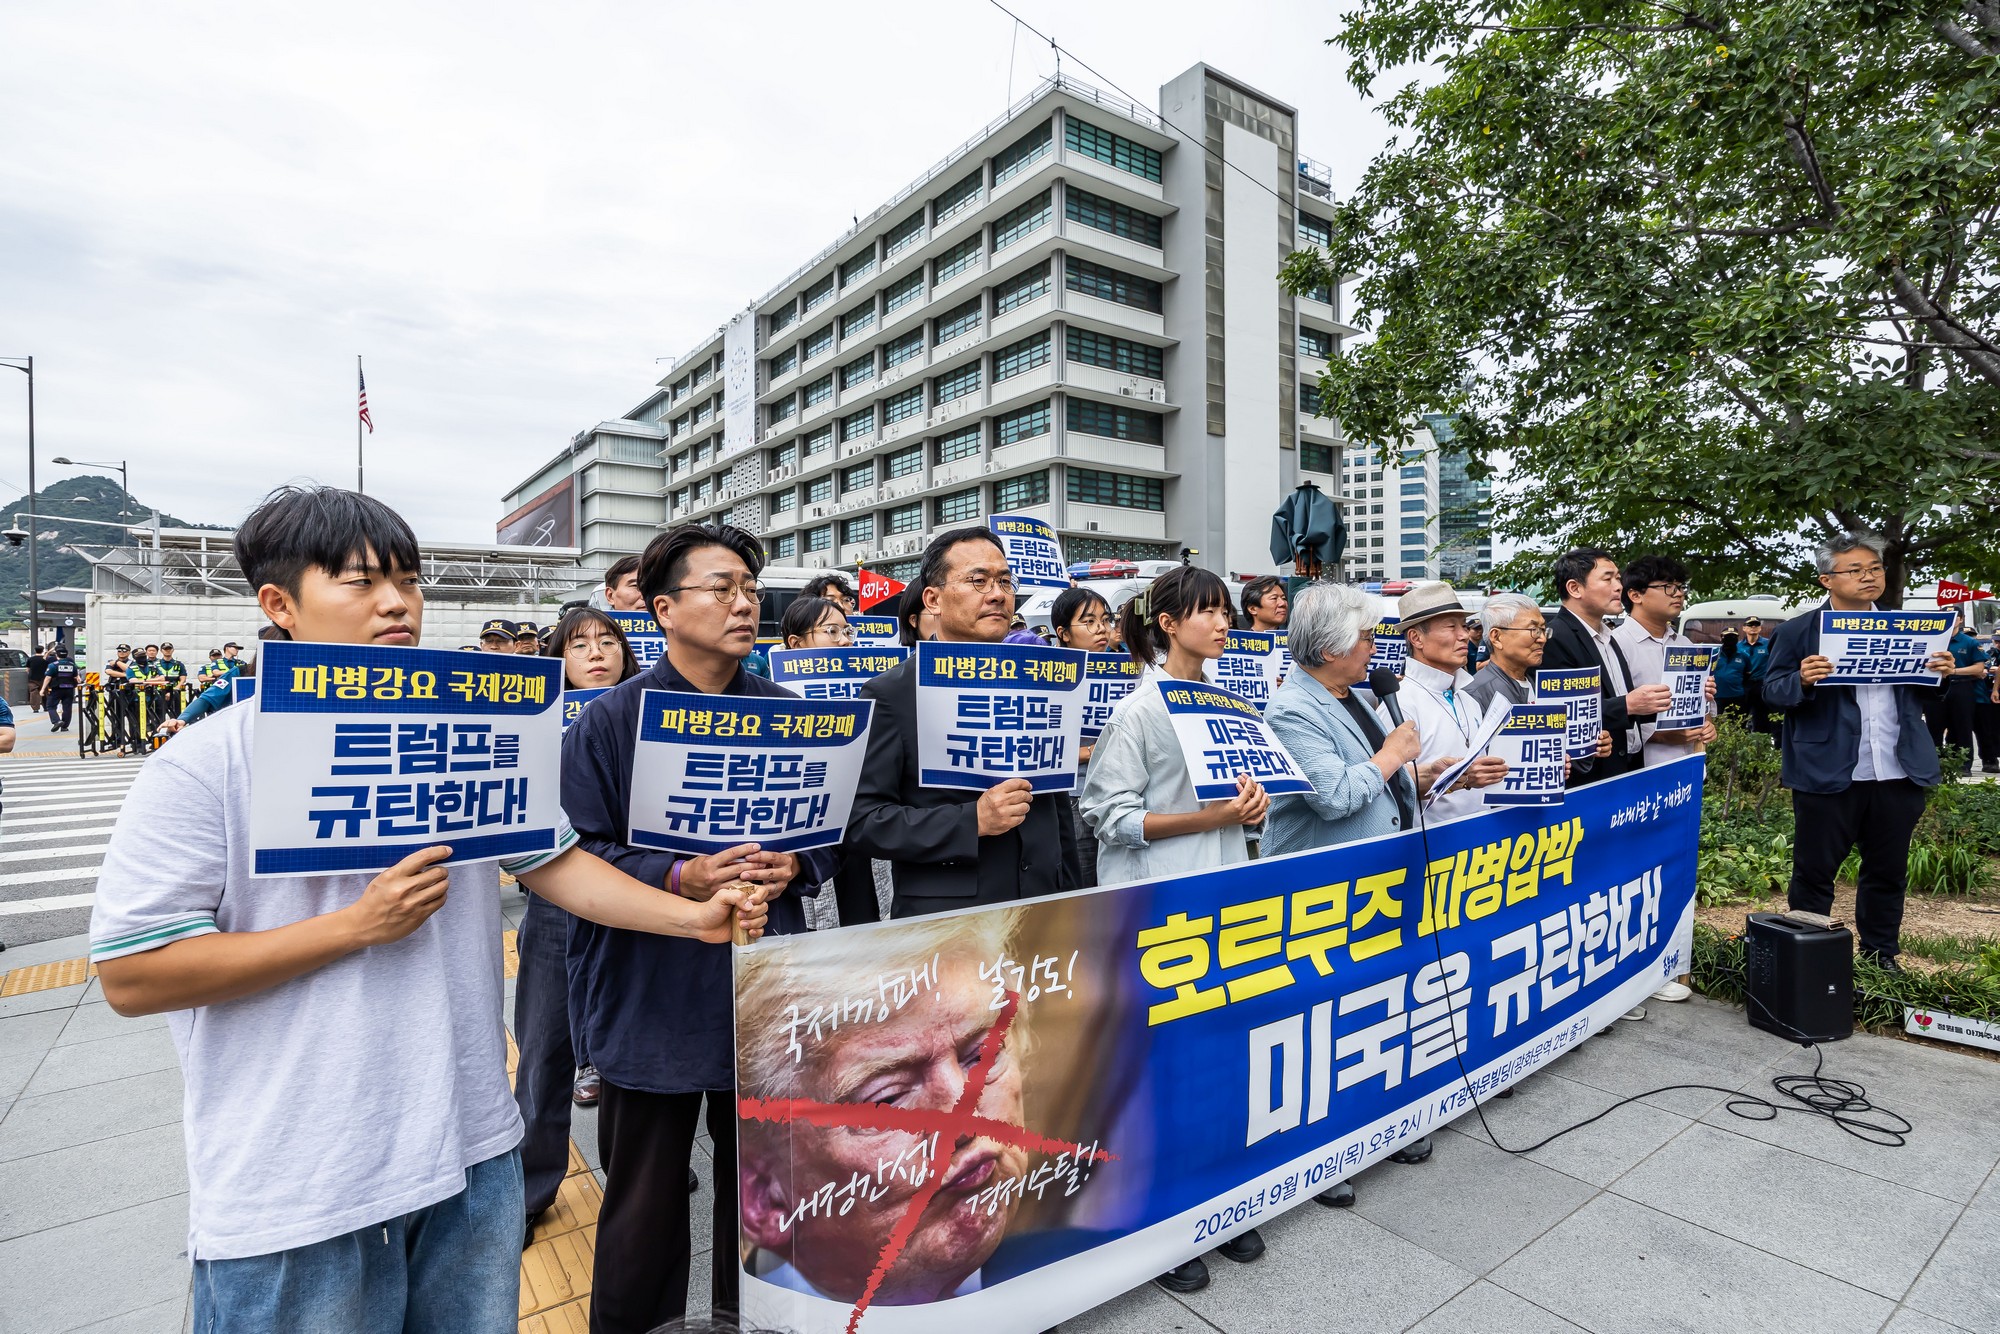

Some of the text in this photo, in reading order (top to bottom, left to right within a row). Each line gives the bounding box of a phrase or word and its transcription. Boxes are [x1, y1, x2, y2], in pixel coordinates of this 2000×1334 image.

[997, 521, 1034, 533] 파병강요
[1010, 539, 1058, 559] 트럼프를
[1006, 558, 1064, 578] 규탄한다!
[861, 580, 890, 599] 43기-3
[1939, 588, 1974, 600] 43기-1
[615, 618, 658, 632] 병강요
[856, 622, 893, 634] 국제깡패
[1372, 624, 1400, 636] 병강
[1832, 618, 1947, 631] 파병강요 국제깡패
[1240, 638, 1270, 652] 국제깡패
[1846, 638, 1927, 656] 트럼프를
[783, 656, 900, 674] 파병강요 국제깡패
[932, 656, 1078, 684] 파병강요 국제깡패
[1086, 662, 1118, 674] 르무즈
[1217, 657, 1264, 677] 트럼프를
[1668, 654, 1692, 667] 호르무즈
[1836, 658, 1930, 674] 규탄한다!
[290, 664, 546, 704] 파병강요 국제깡패
[1542, 679, 1561, 691] 이란
[1562, 676, 1591, 690] 침략전쟁
[1675, 674, 1702, 694] 미국을
[1166, 690, 1192, 704] 이란
[1193, 692, 1232, 708] 침략전쟁
[956, 694, 1062, 731] 트럼프를
[660, 708, 856, 738] 파병강요 국제깡패
[1205, 719, 1269, 747] 미국을
[330, 722, 520, 776] 트럼프를
[946, 734, 1064, 772] 규탄한다!
[1521, 738, 1562, 762] 미국을
[682, 752, 828, 792] 트럼프를
[1203, 748, 1296, 780] 규탄한다!
[308, 777, 528, 839] 규탄한다!
[664, 793, 829, 836] 규탄한다!
[1137, 816, 1584, 1027] 호르무즈 파병압박
[978, 950, 1078, 1010] 날강도!
[1246, 865, 1662, 1148] 미국을 규탄한다!
[1194, 1188, 1265, 1244] 2026년
[1270, 1172, 1299, 1206] 9월
[1303, 1142, 1364, 1188] 10일(목)
[1368, 1125, 1397, 1156] 오후
[1398, 1110, 1422, 1140] 2시
[1553, 1028, 1569, 1052] 2번
[1570, 1016, 1588, 1042] 출구)
[779, 1130, 940, 1233] 내정간섭!
[966, 1140, 1098, 1216] 경제수탈!
